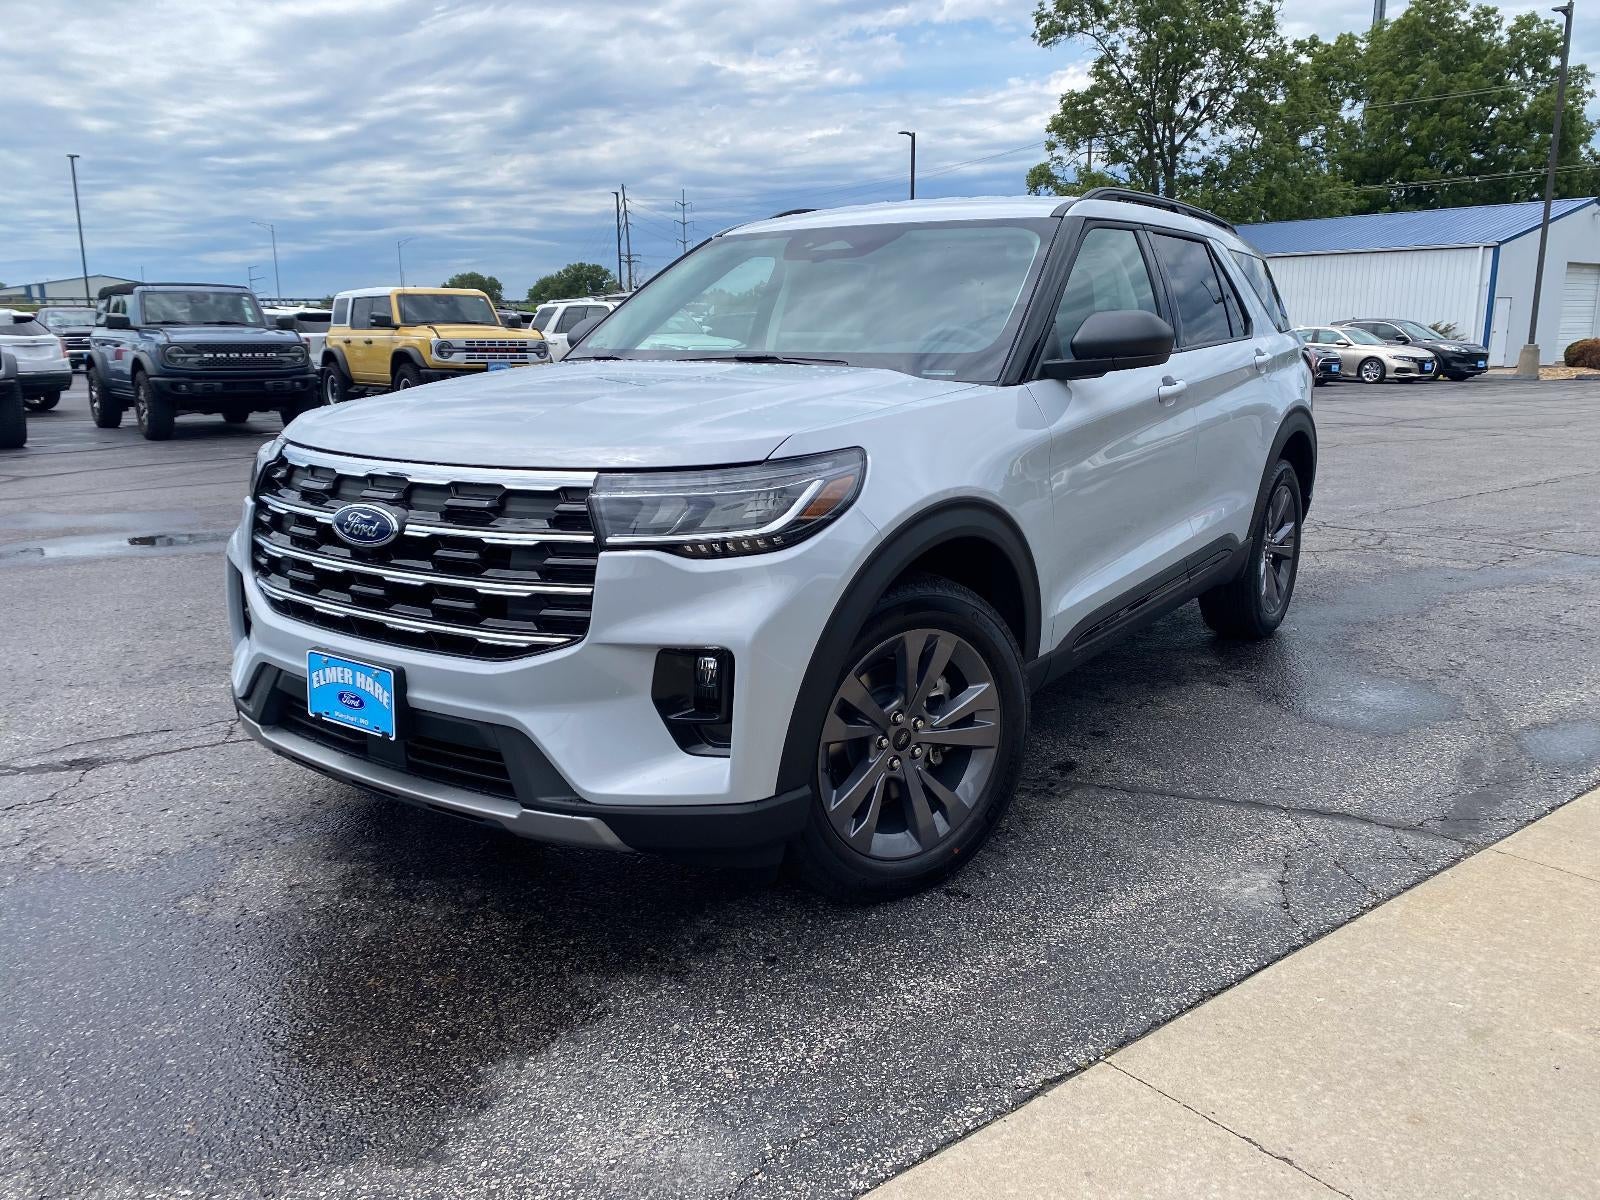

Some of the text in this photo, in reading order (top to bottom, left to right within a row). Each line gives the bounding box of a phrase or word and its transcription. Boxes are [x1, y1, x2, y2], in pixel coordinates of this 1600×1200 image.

[343, 512, 379, 537] Ford
[311, 666, 391, 710] ELMER HARE
[341, 692, 360, 707] Ford
